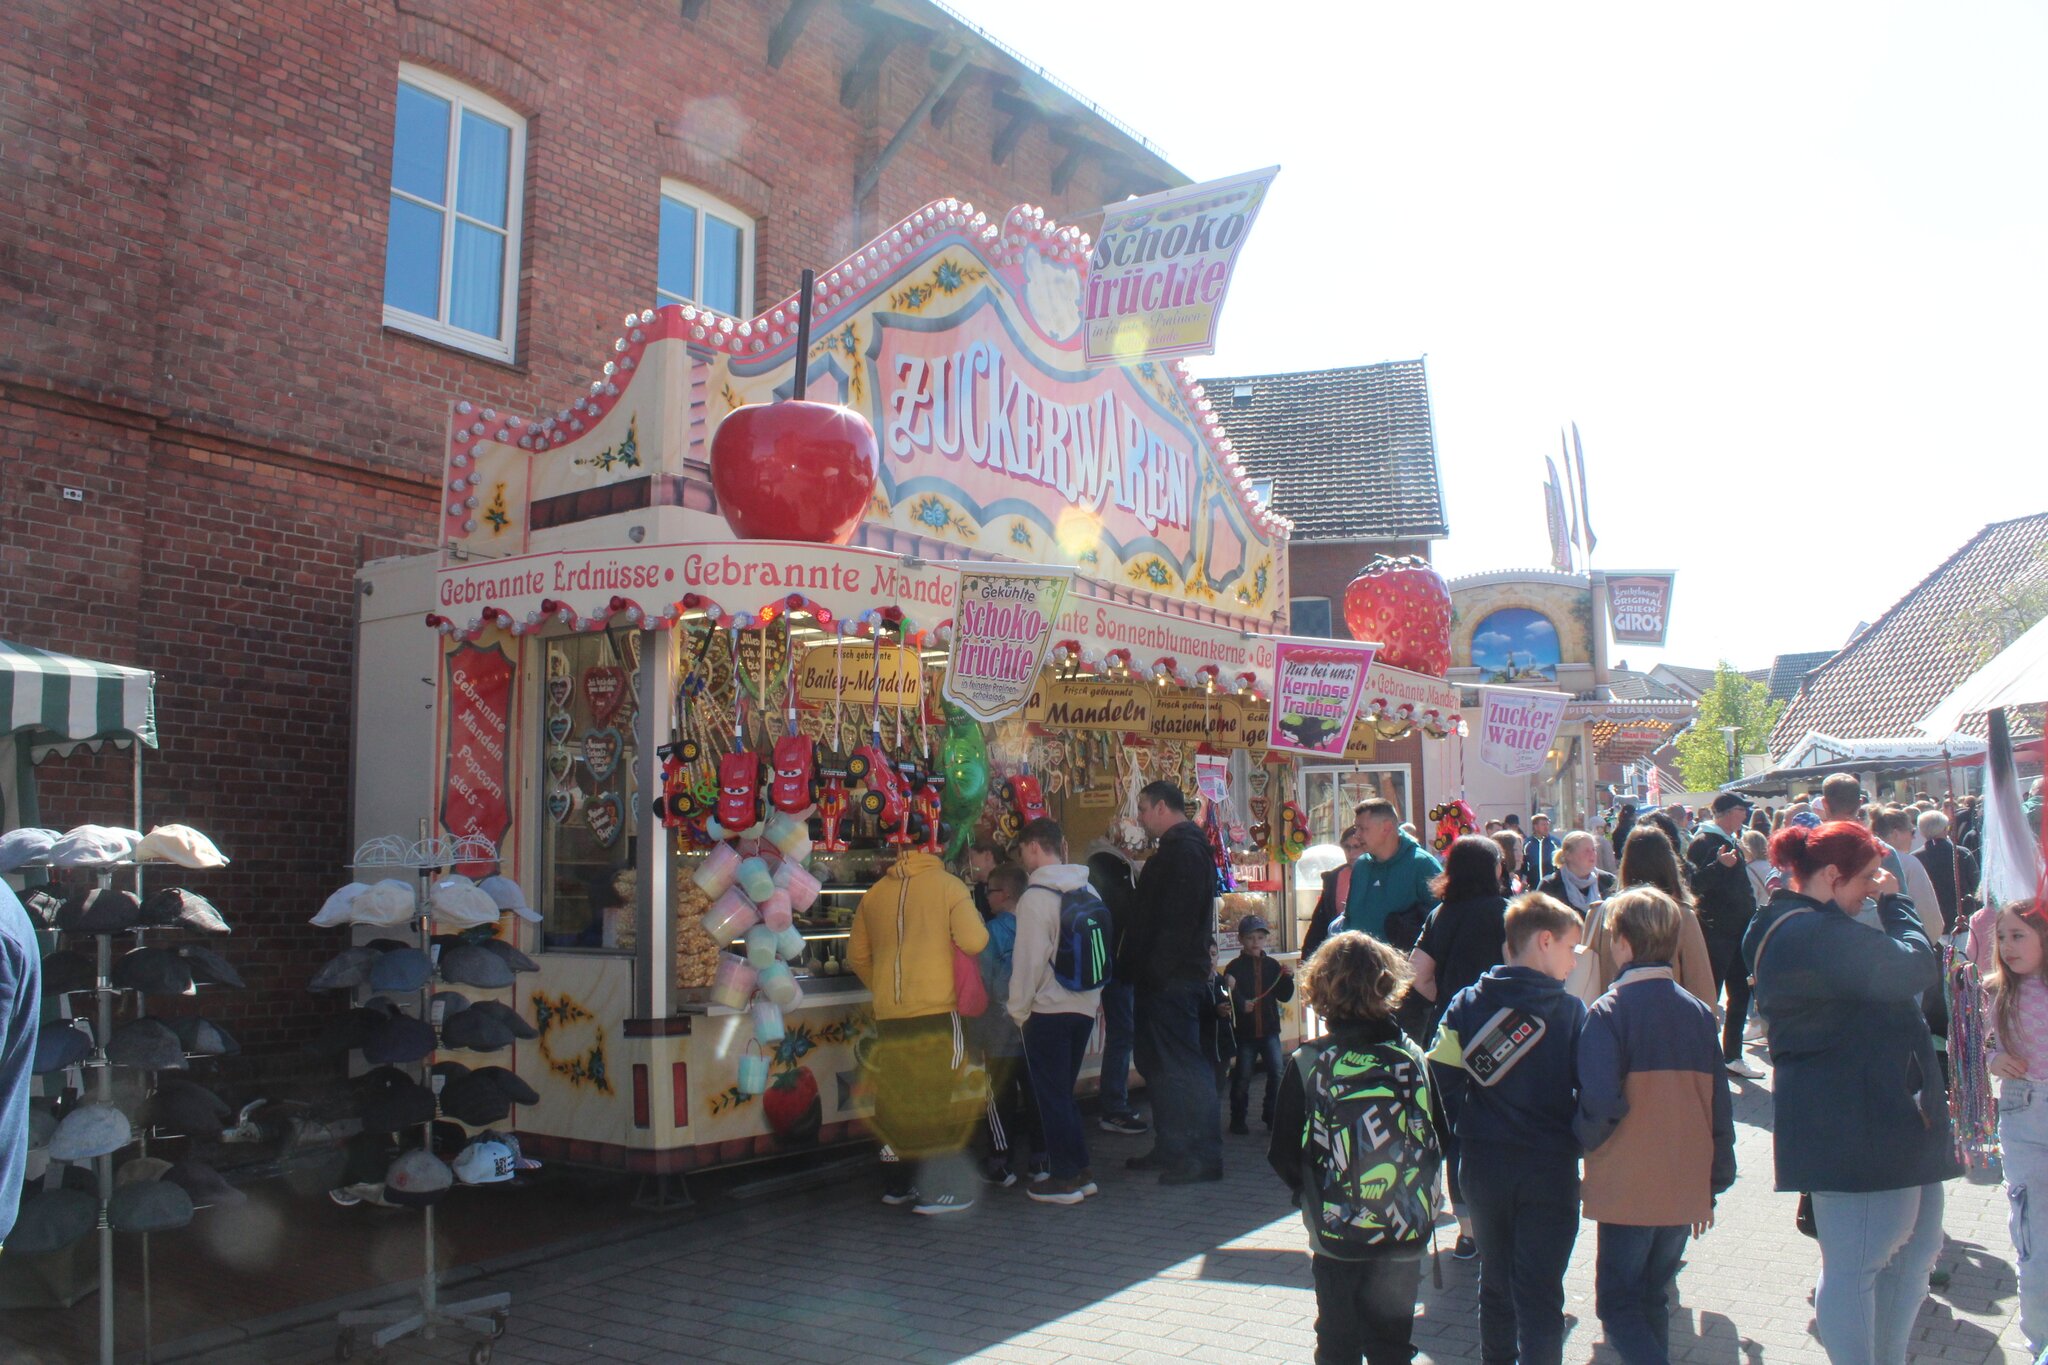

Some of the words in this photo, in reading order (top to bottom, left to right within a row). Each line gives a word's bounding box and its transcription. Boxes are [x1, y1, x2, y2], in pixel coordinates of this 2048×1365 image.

[1093, 213, 1246, 271] Schoko
[1086, 256, 1227, 321] früchte
[888, 339, 1190, 533] ZUCKERWAREN
[440, 570, 545, 606] Gebrannte
[553, 559, 660, 592] Erdnüsse
[684, 553, 860, 593] Gebrannte
[981, 585, 1036, 603] Gekühlte
[962, 599, 1049, 642] Schoko-
[1614, 612, 1663, 632] GIROS
[1095, 607, 1246, 665] Sonnenblumenkerne
[957, 637, 1034, 682] früchte
[1284, 661, 1310, 677] Nur
[1310, 662, 1329, 678] bei
[1063, 685, 1088, 696] Frisch
[1090, 685, 1134, 698] gebrannte
[1282, 676, 1349, 700] Kernlose
[1377, 672, 1425, 702] Gebrannte
[453, 669, 506, 734] Gebrannte
[1046, 698, 1146, 725] Mandeln
[1156, 699, 1180, 710] Frisch
[1282, 695, 1343, 719] Trauben
[1568, 706, 1593, 714] PITA
[1489, 703, 1554, 730] Zucker-
[458, 708, 504, 762] Mandeln
[1488, 725, 1547, 751] watte
[457, 744, 502, 800] Popcorn
[1341, 1050, 1378, 1067] NIKE
